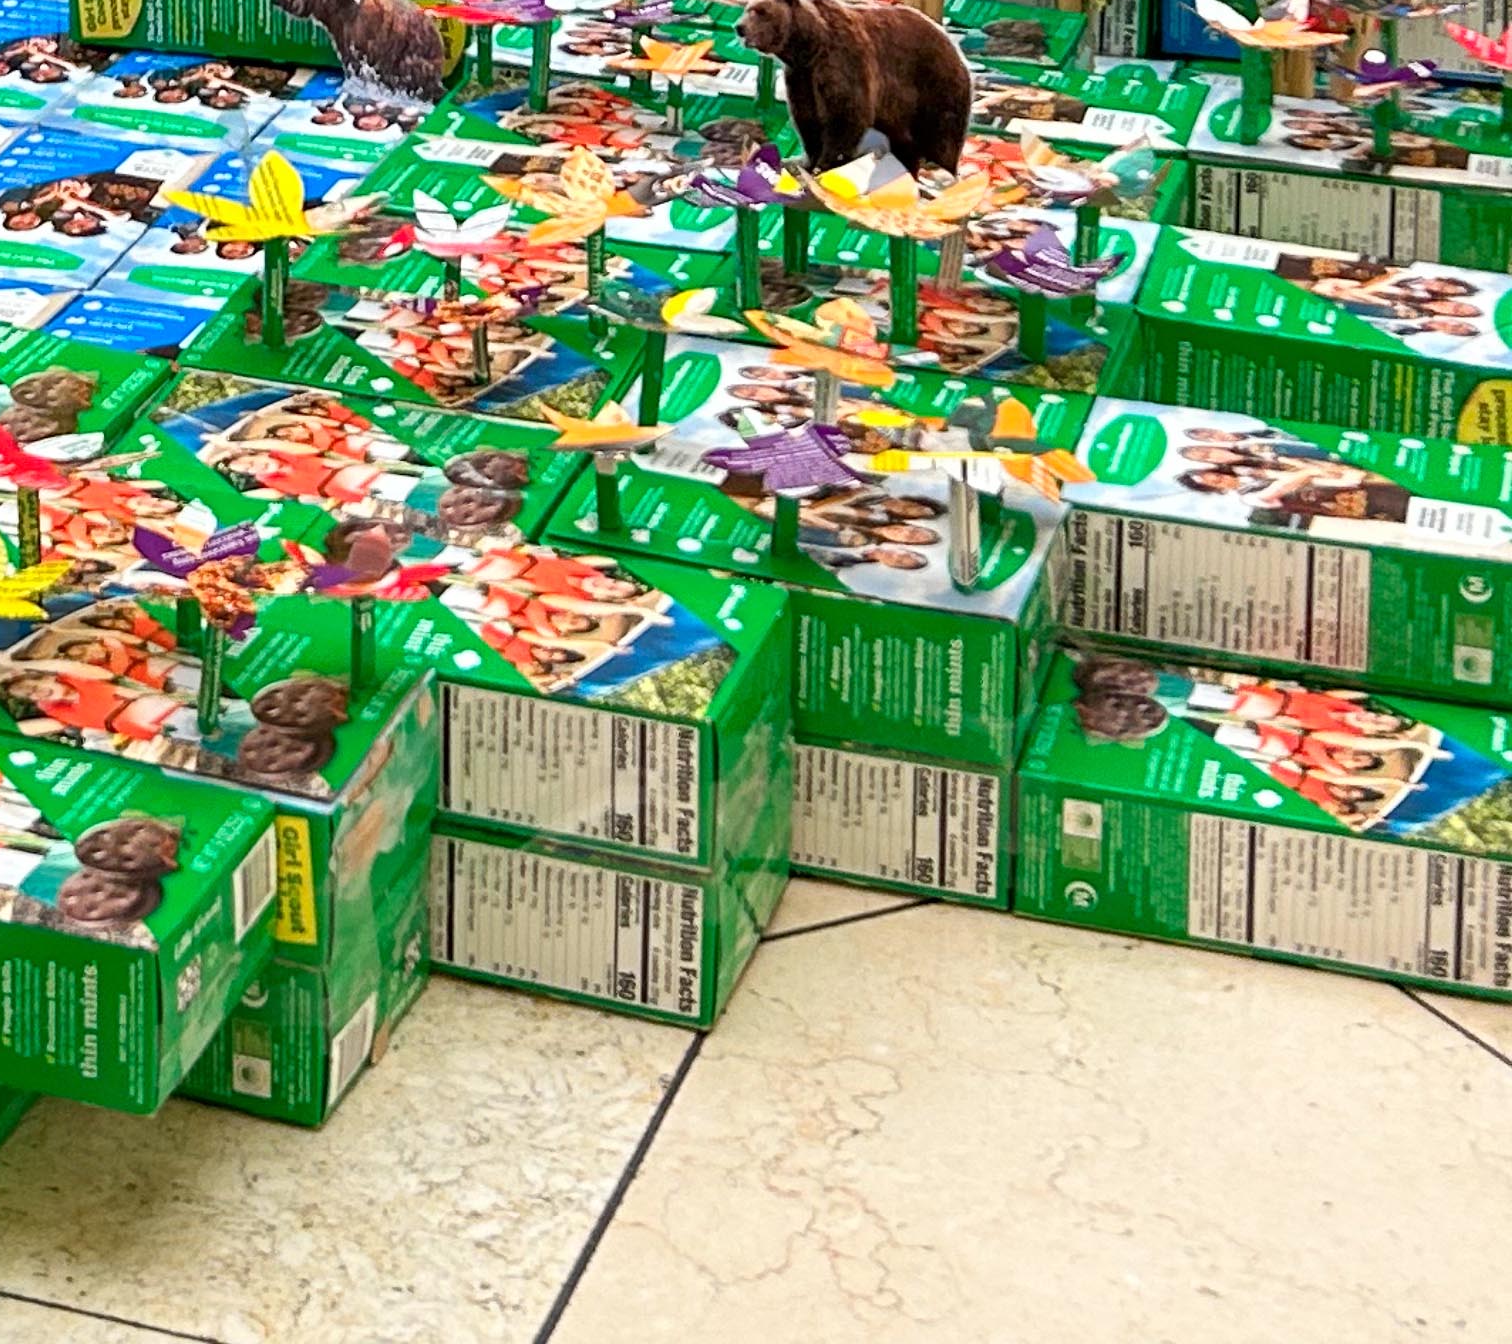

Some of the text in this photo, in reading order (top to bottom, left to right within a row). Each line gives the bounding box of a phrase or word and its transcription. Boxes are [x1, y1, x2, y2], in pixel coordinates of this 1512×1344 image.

[282, 826, 301, 867] Girl
[676, 808, 695, 853] Facts
[80, 1034, 98, 1078] thin
